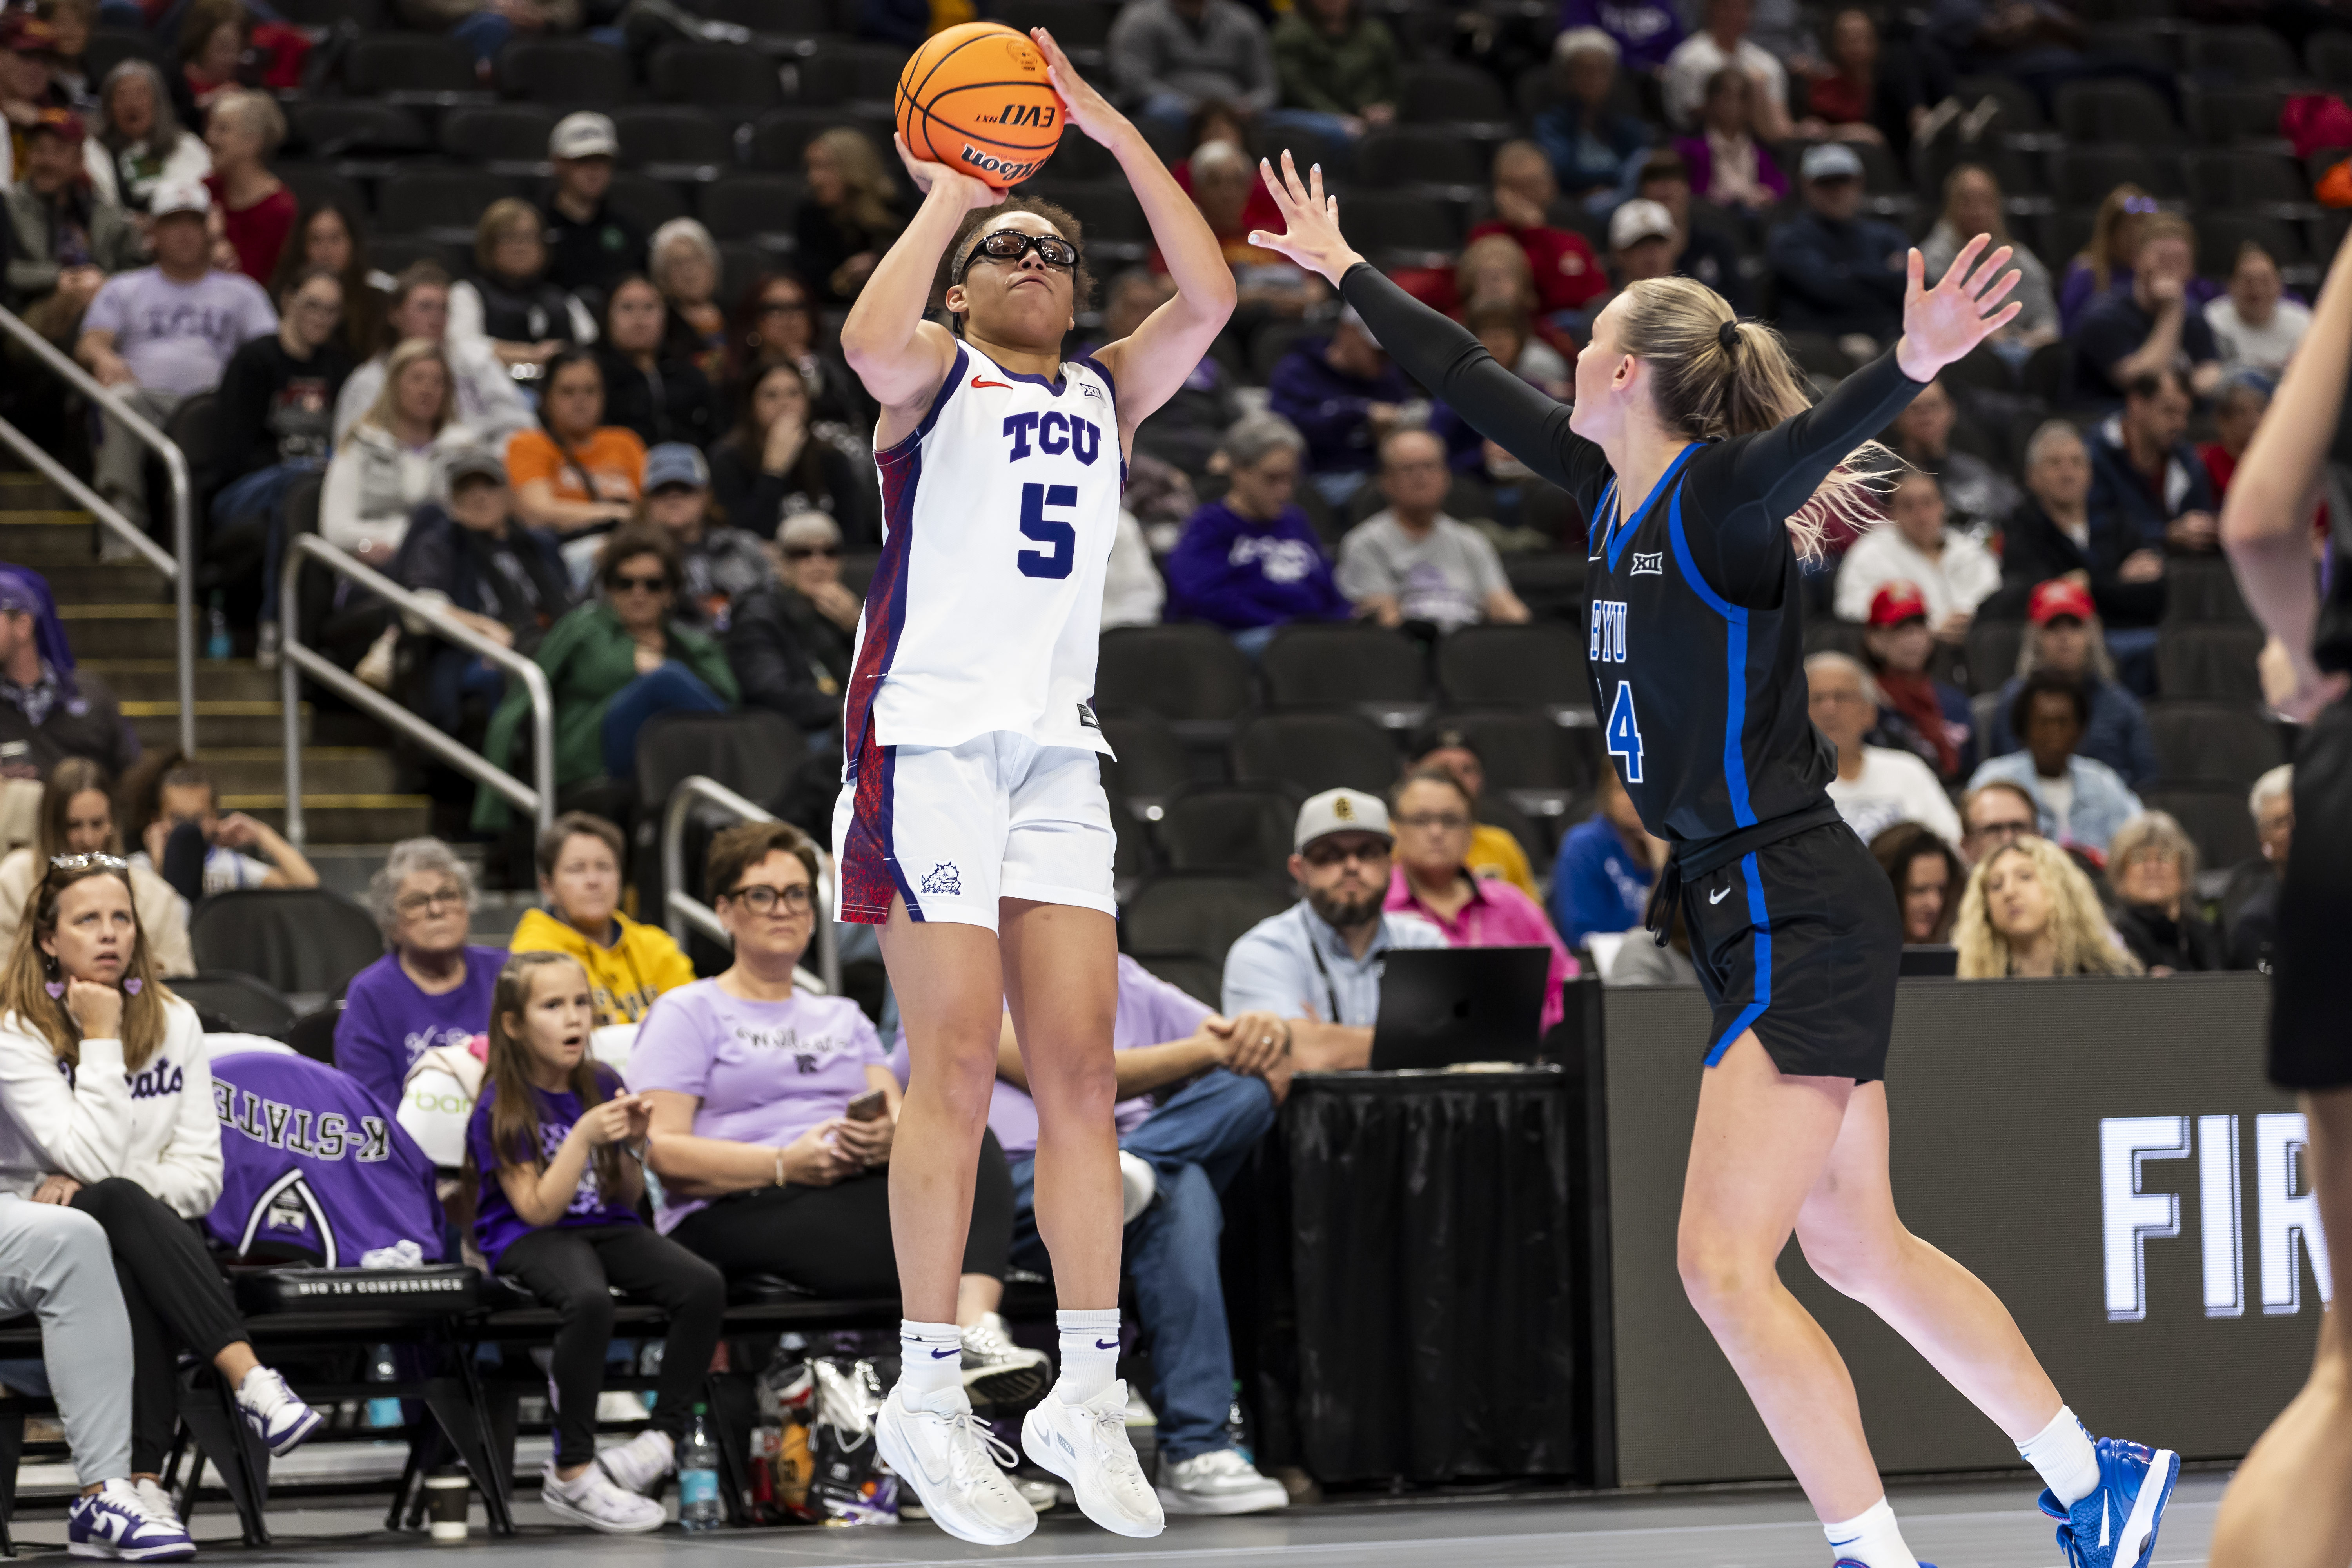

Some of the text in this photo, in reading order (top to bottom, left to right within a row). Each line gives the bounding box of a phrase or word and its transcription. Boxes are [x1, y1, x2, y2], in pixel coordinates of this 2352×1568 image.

[974, 104, 1055, 127] EVO NXT
[1003, 411, 1101, 466] TCU
[1017, 483, 1078, 579] 5
[1630, 551, 1663, 576] XII
[1590, 600, 1627, 663] BYU
[1597, 678, 1644, 782] 4
[212, 1075, 390, 1163] K-STATE
[299, 1278, 463, 1294] BIG 12 CONFERENCE
